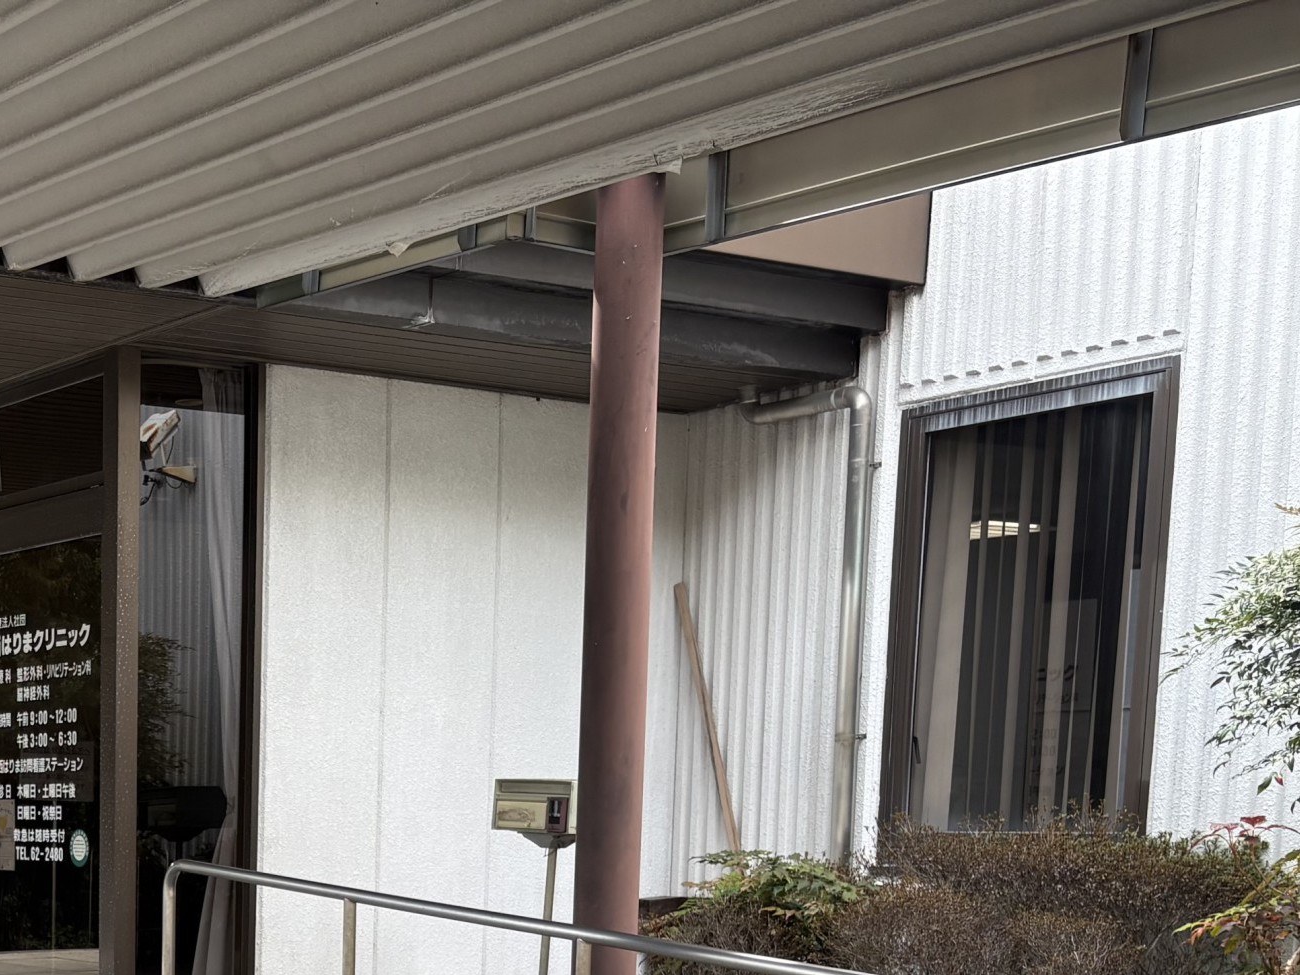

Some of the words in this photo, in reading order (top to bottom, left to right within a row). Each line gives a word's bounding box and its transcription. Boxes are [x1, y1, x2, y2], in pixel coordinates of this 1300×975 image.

[16, 685, 50, 702] 脳神経外科
[13, 828, 65, 843] 救急は随時受付
